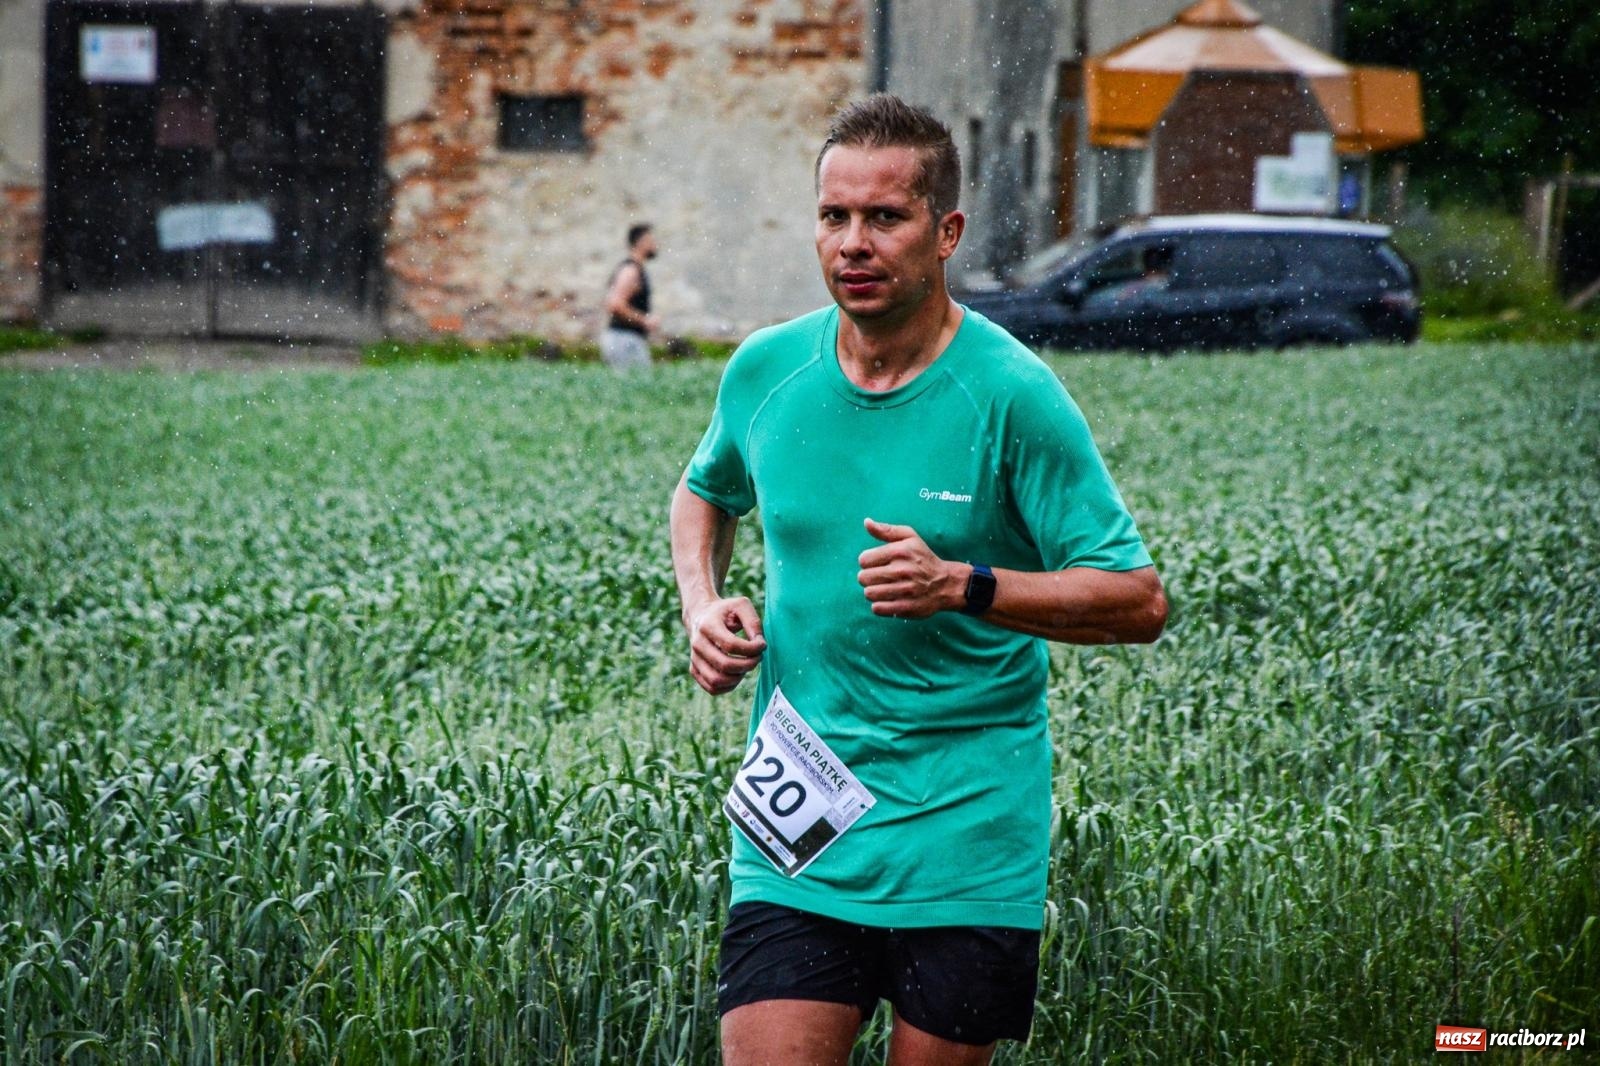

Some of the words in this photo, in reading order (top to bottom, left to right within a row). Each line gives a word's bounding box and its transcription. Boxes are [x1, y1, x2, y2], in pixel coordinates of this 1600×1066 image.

[919, 487, 972, 502] GymBeam
[774, 709, 797, 734] BIEG
[794, 732, 811, 752] NA
[810, 750, 848, 792] PIĄTKĘ
